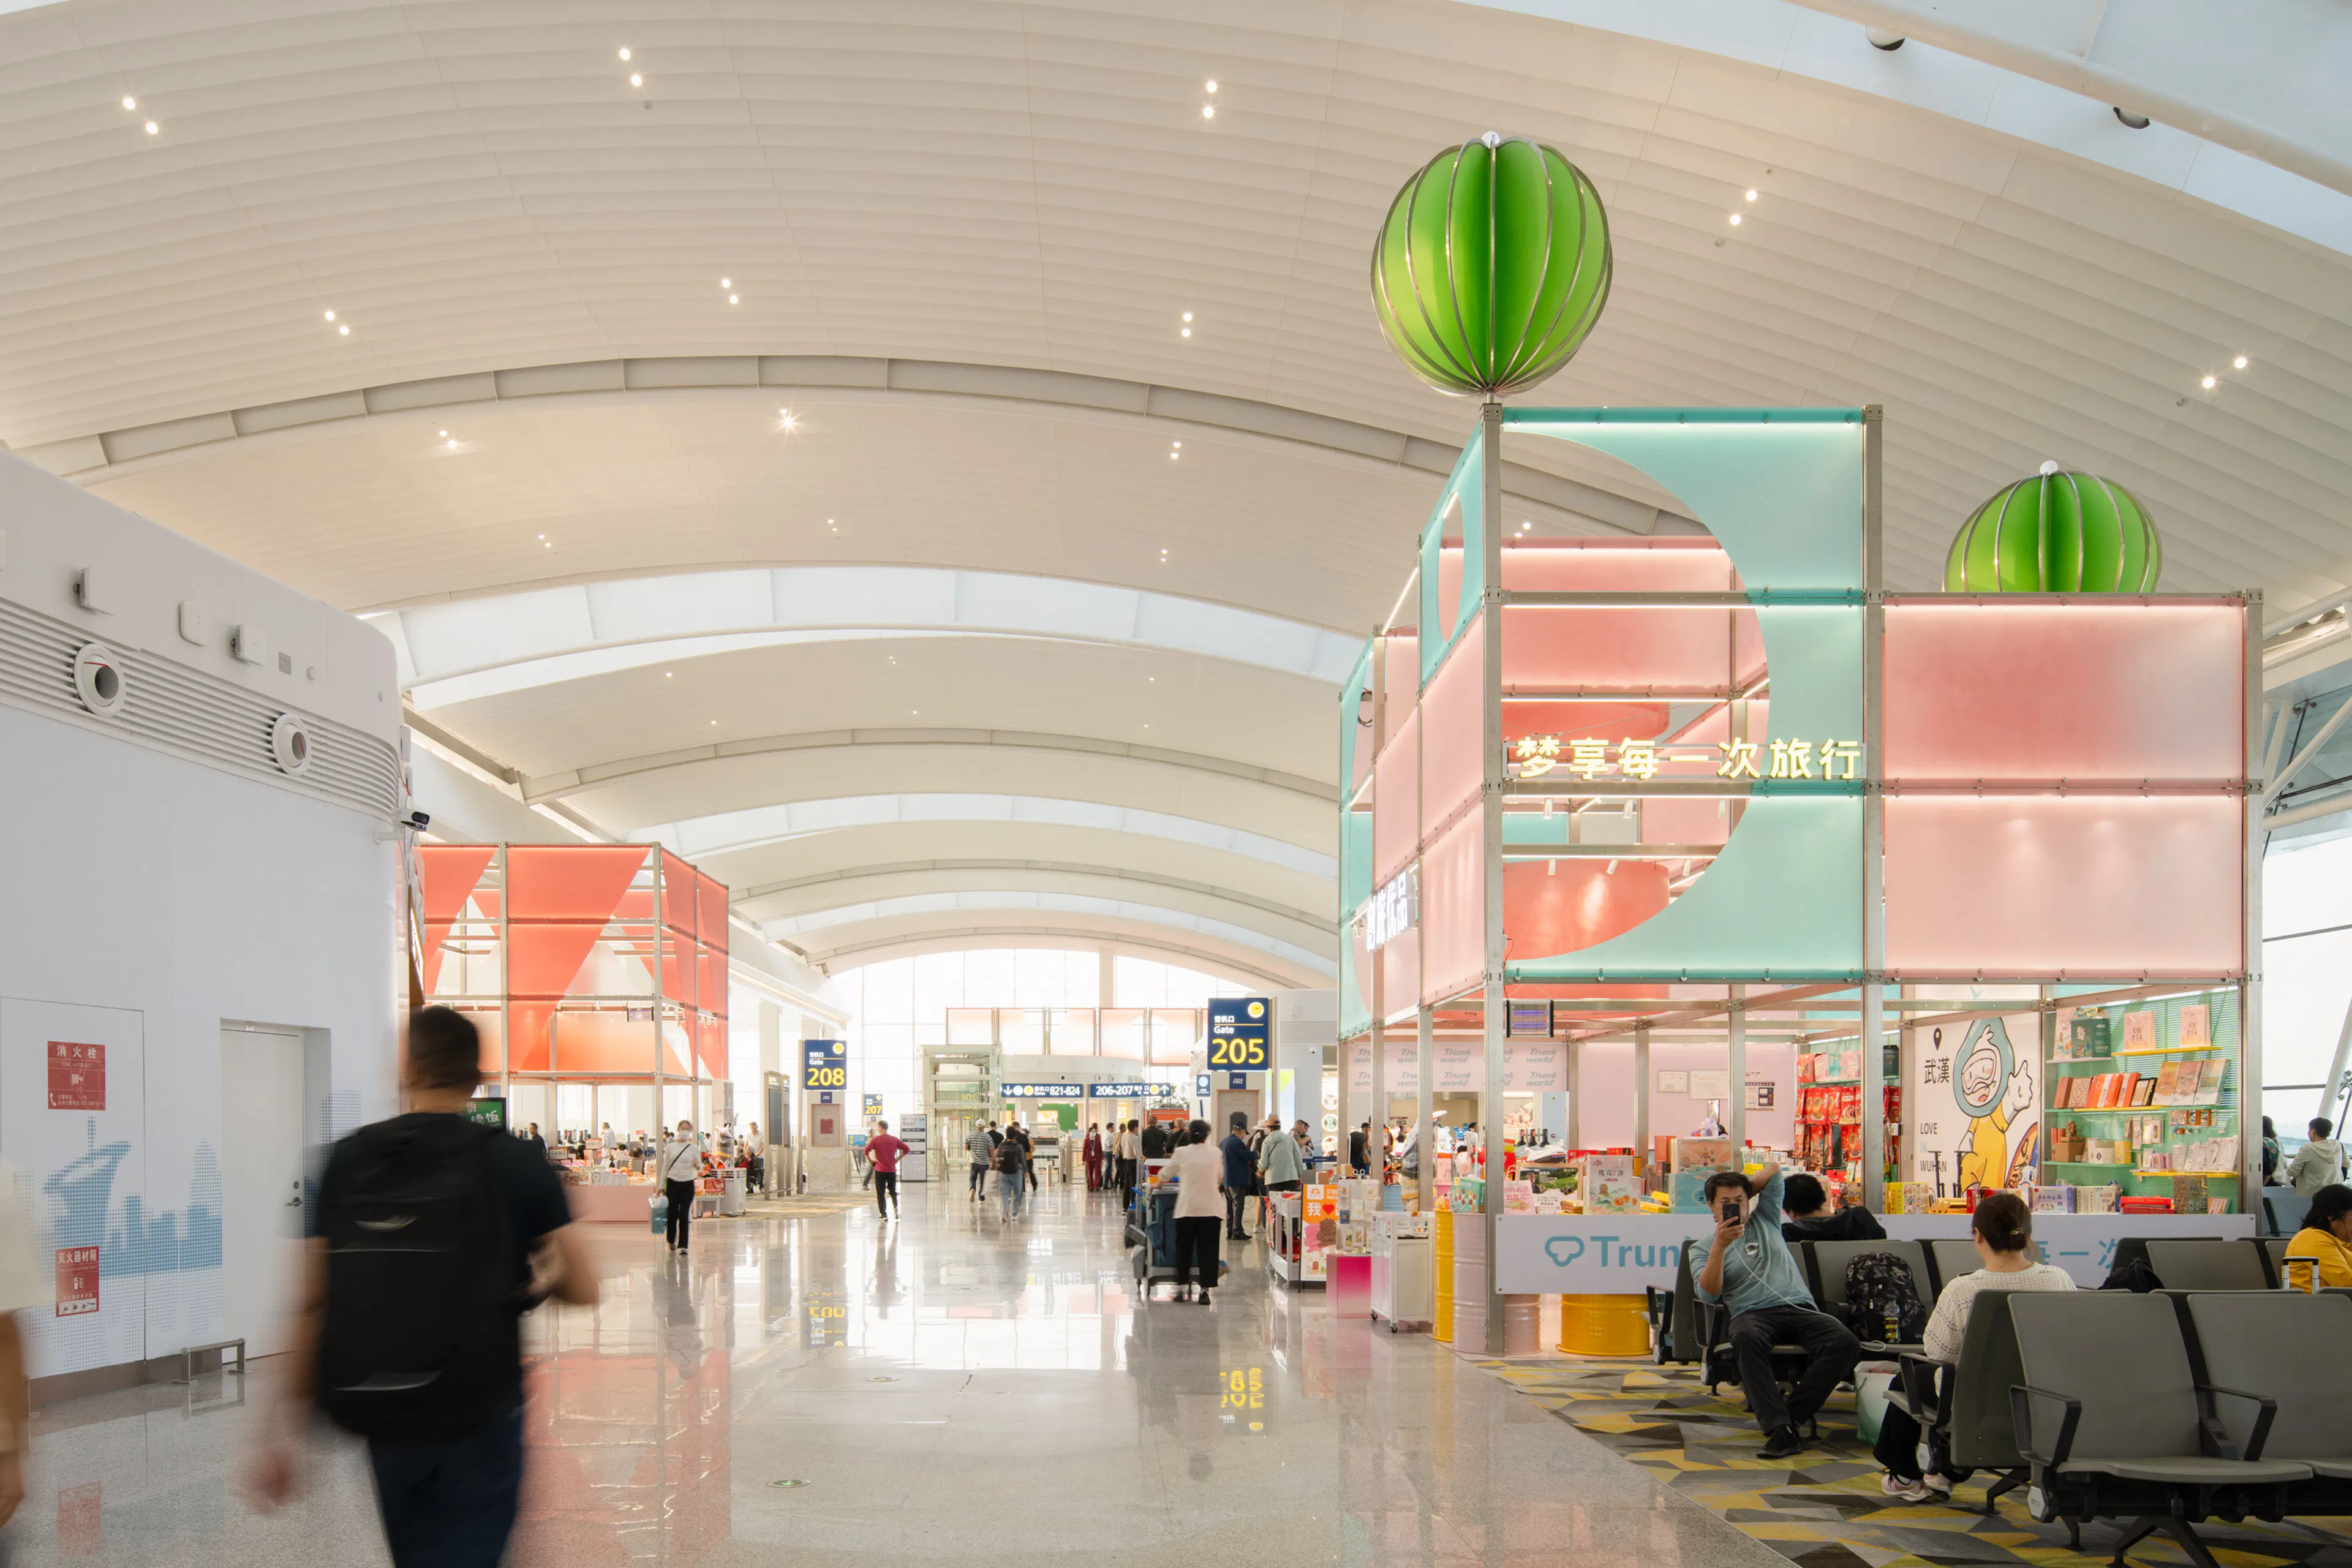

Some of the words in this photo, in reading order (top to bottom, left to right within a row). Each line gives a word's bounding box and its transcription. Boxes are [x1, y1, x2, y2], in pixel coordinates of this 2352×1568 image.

[1516, 736, 1861, 781] 梦享每一次旅行
[1214, 1015, 1235, 1023] 登机口
[57, 1044, 97, 1058] 消火栓
[1211, 1038, 1264, 1064] 205
[807, 1068, 845, 1086] 208
[1924, 1057, 1950, 1084] 武漢
[1050, 1086, 1080, 1095] 821-824
[1096, 1085, 1133, 1095] 206-207
[865, 1106, 881, 1114] 207
[1920, 1123, 1937, 1134] LOVE
[1920, 1141, 1928, 1153] IN
[1920, 1160, 1947, 1172] WUHAN
[1307, 1202, 1321, 1216] 我
[58, 1250, 97, 1264] 灭火器材箱
[1590, 1236, 1691, 1267] Trun
